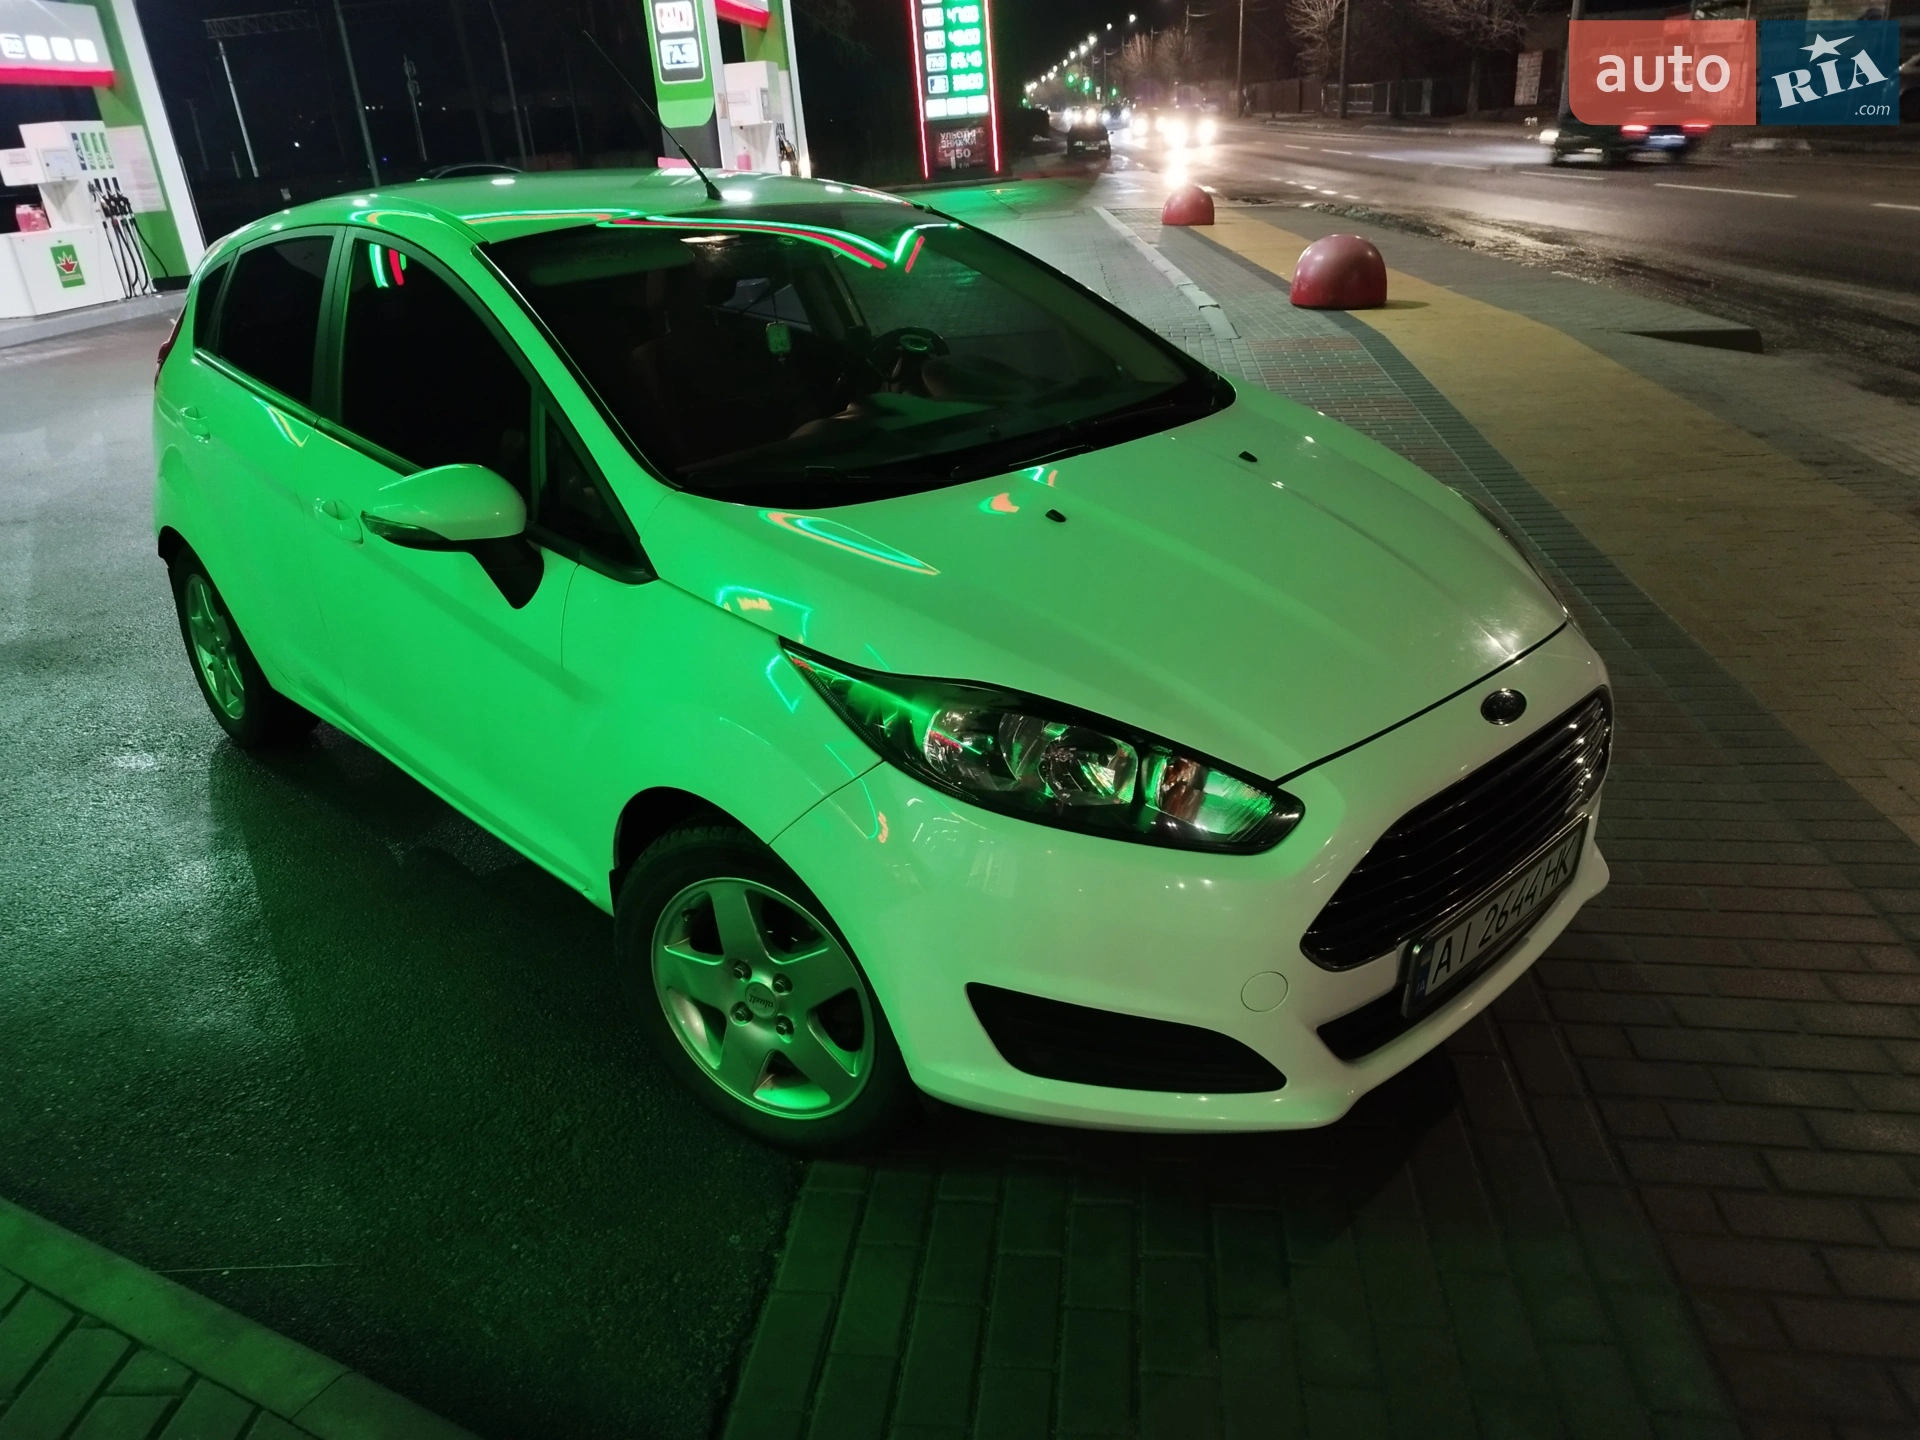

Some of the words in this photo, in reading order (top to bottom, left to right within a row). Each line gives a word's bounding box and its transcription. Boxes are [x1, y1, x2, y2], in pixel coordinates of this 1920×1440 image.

[940, 137, 977, 148] ЗНИЖКИ
[1431, 922, 1472, 984] AI
[1478, 869, 1541, 949] 2644
[1539, 835, 1577, 898] HK
